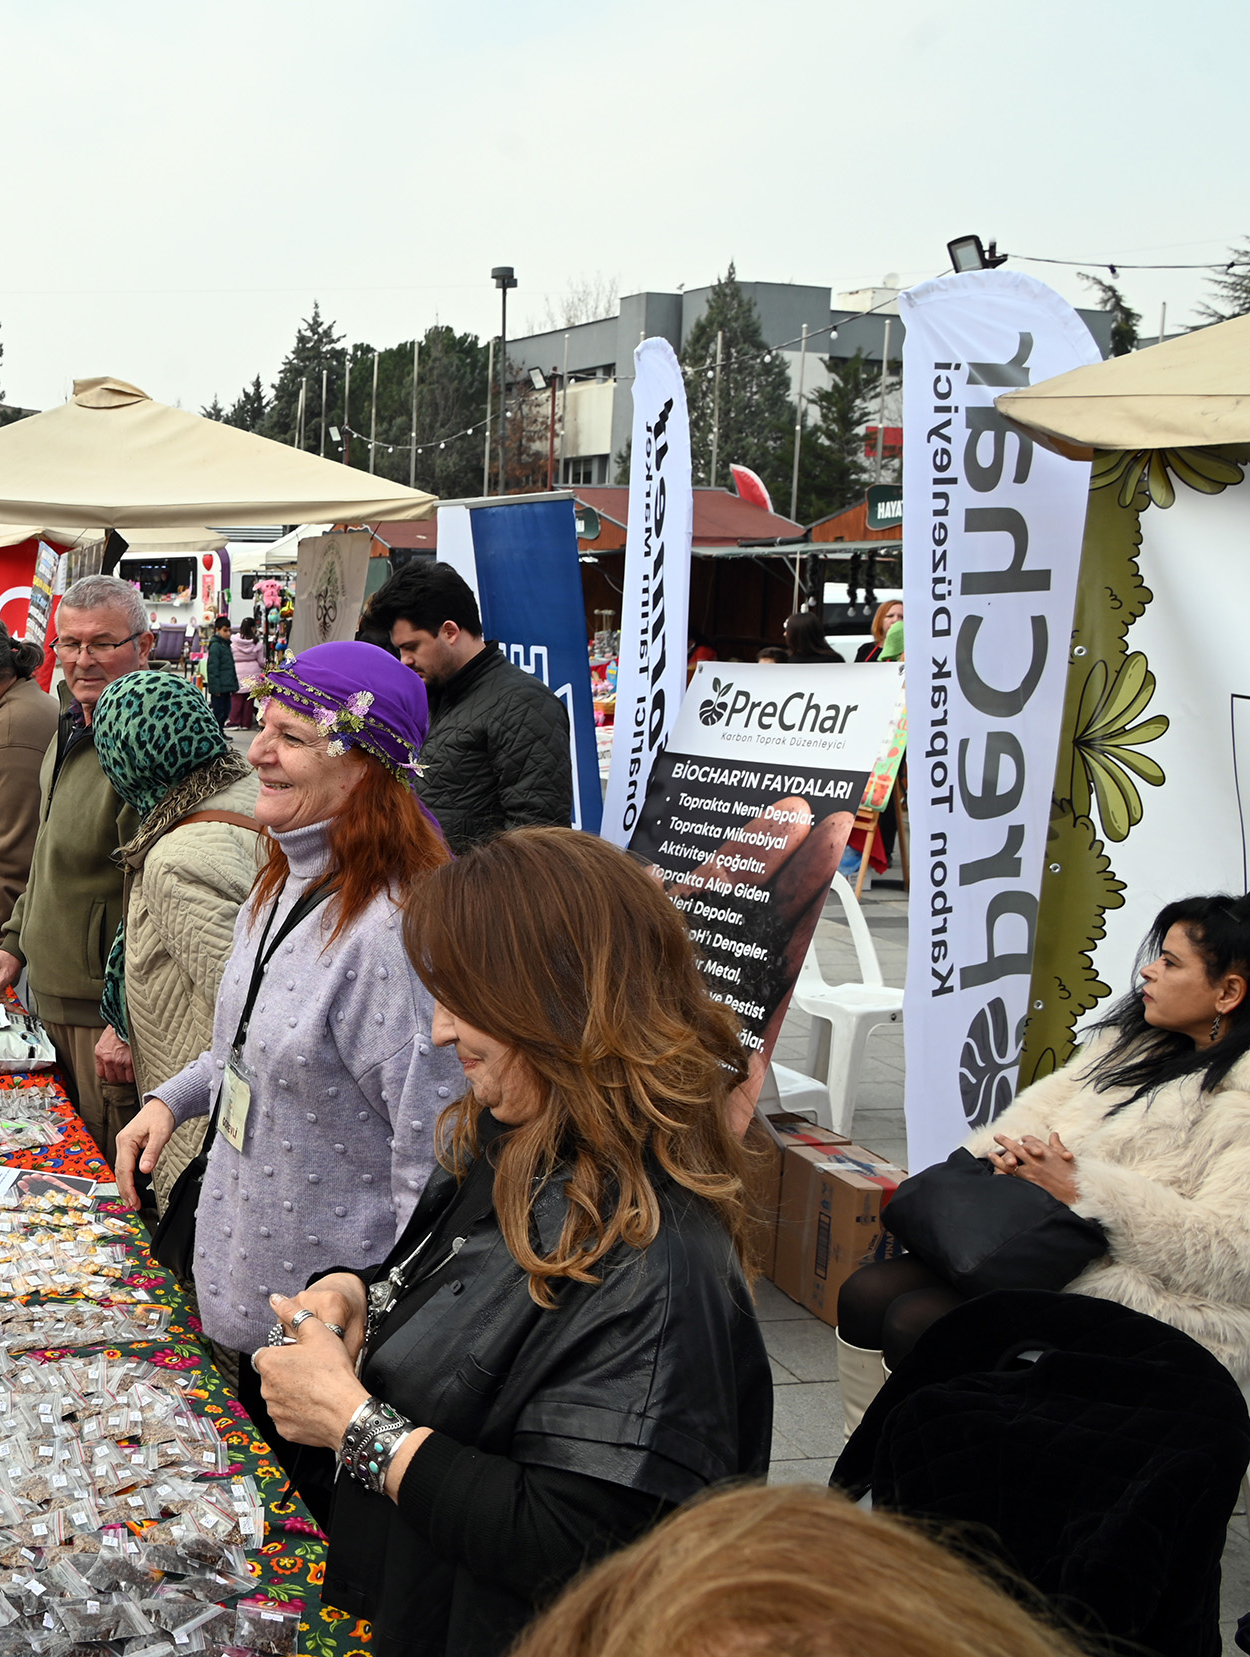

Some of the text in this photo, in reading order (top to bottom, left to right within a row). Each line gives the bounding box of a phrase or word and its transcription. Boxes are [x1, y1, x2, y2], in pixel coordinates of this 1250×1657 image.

[877, 499, 903, 519] HAYA
[725, 689, 859, 735] PreChar
[721, 731, 846, 751] Karbon Toprak Düzenleyici
[761, 774, 854, 800] FAYDALARI
[678, 792, 816, 827] Toprakta Nemi Depolar.
[669, 816, 789, 851] Toprakta Mikrobiyal
[658, 840, 767, 875] Aktiviteyi çoğaltır.
[650, 864, 771, 904] Toprakta Akıp Giden
[668, 894, 744, 926] leri Depolar.
[712, 933, 768, 961] Dengeler.
[703, 959, 741, 985] Metal,
[737, 1028, 765, 1054] ğlar,
